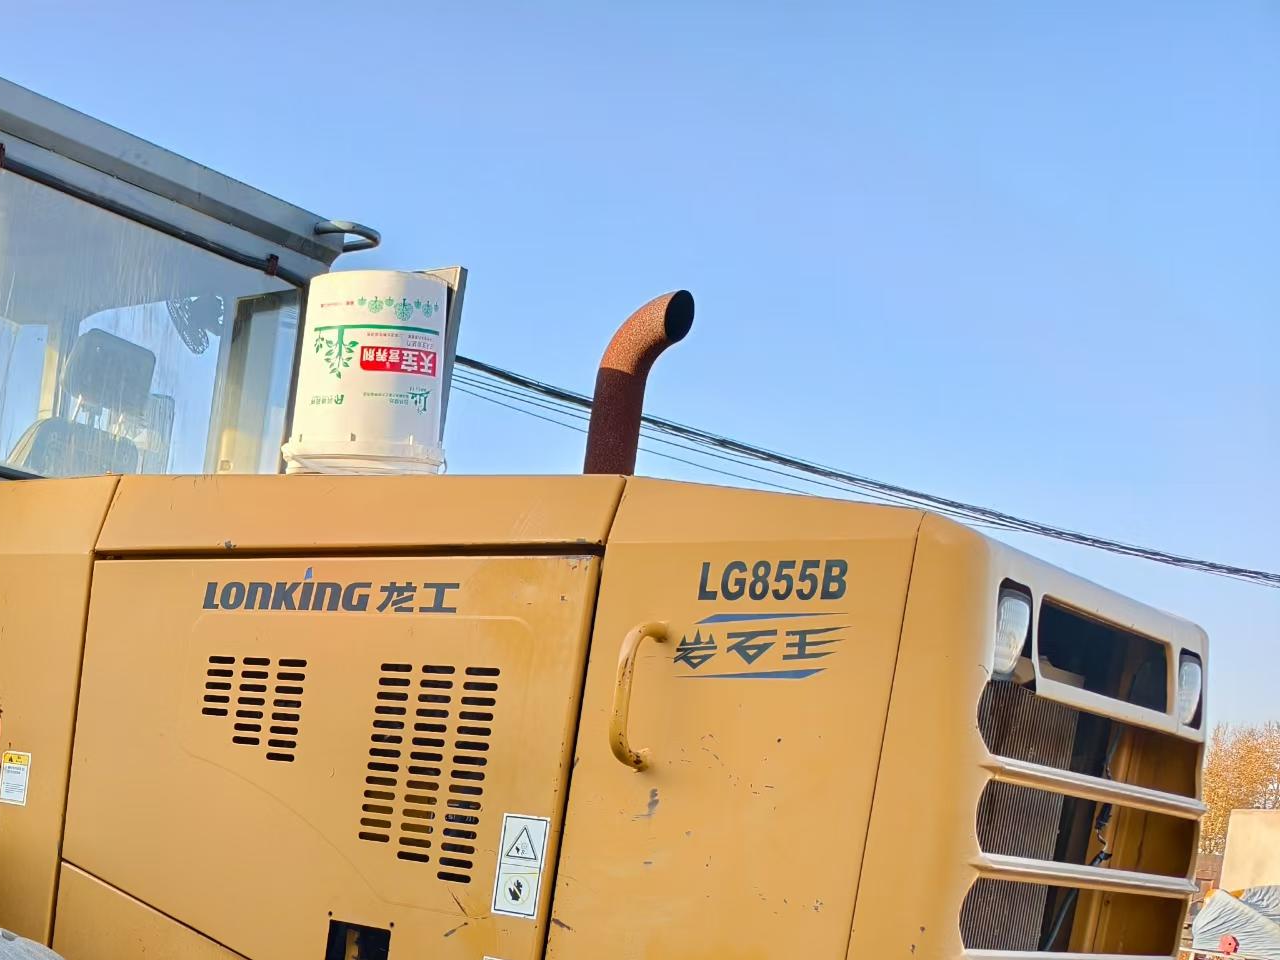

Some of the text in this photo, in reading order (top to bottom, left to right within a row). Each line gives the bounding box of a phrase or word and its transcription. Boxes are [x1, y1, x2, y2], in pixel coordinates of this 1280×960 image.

[362, 347, 434, 375] 天宝营养剂
[376, 581, 460, 613] 龙工
[697, 559, 849, 601] LG855B
[673, 625, 853, 670] 岩石王
